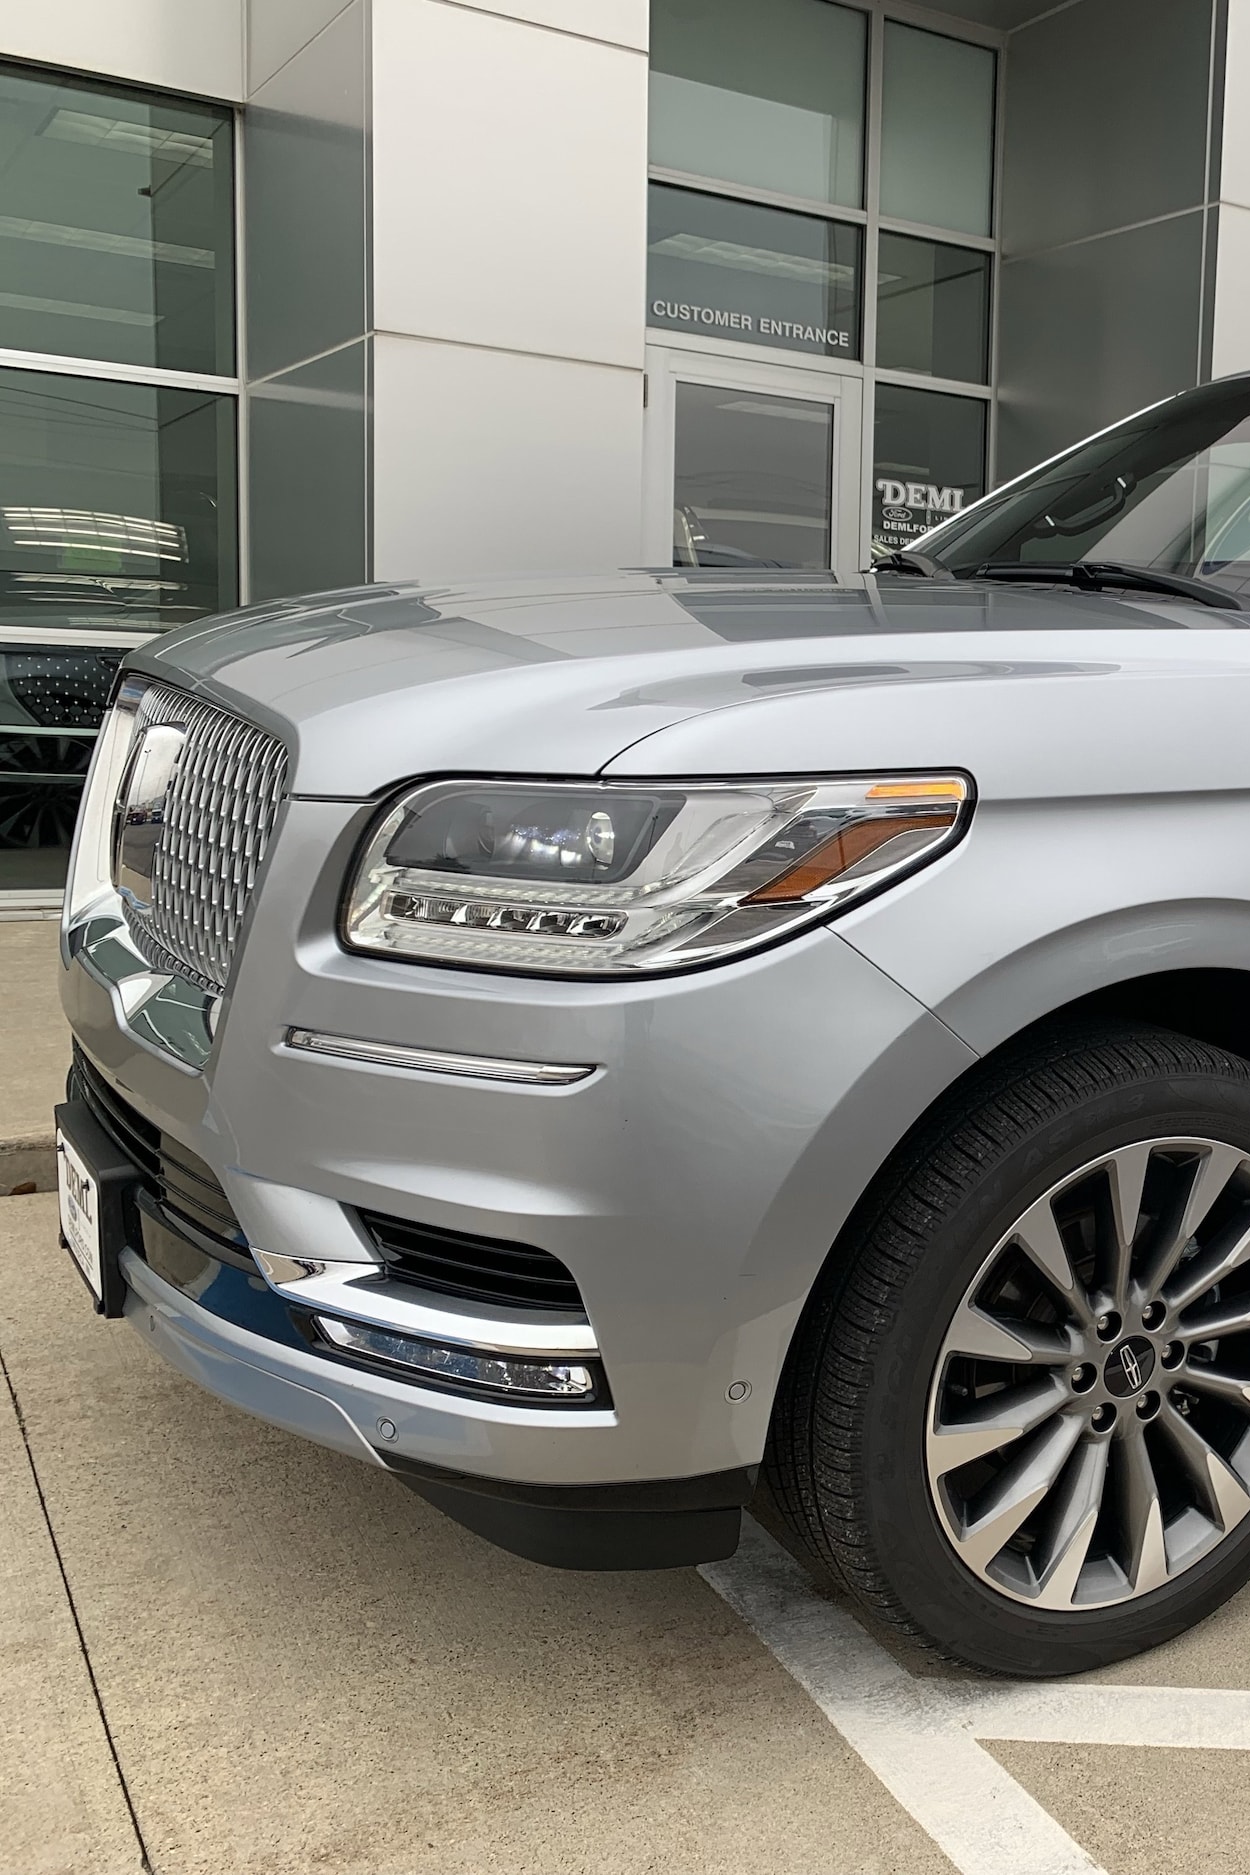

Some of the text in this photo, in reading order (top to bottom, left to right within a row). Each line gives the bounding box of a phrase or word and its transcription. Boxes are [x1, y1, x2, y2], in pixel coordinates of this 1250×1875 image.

[652, 300, 850, 348] CUSTOMER ENTRANCE
[876, 478, 970, 513] DEML
[873, 534, 899, 545] SALES
